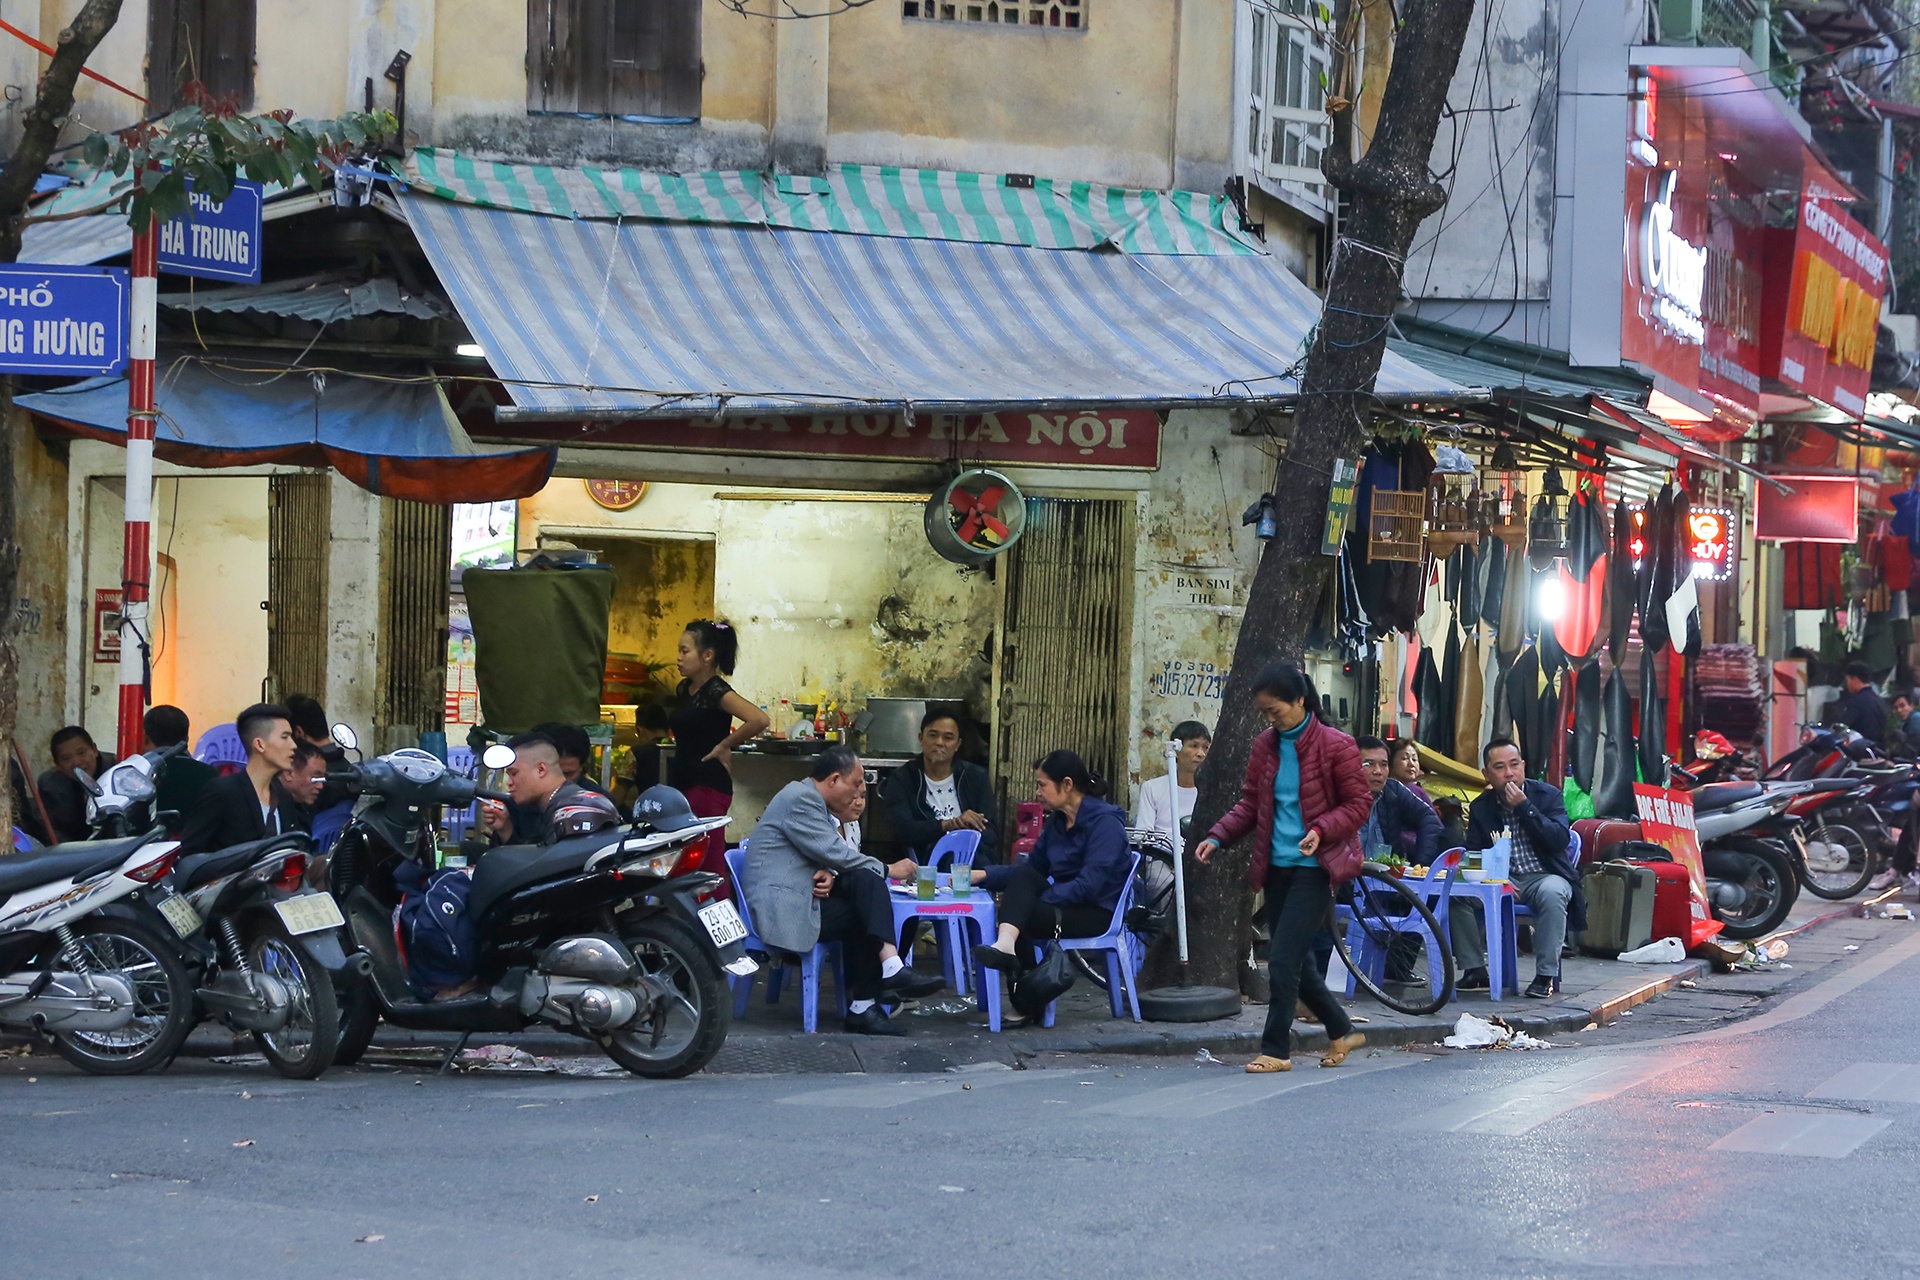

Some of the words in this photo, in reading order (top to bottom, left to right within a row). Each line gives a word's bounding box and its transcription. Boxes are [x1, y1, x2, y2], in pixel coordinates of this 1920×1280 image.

[190, 223, 249, 265] TRUNG
[0, 280, 53, 308] PHỐ
[33, 317, 105, 357] HƯNG
[1026, 410, 1129, 454] NỘI
[1206, 579, 1230, 590] SIM
[704, 904, 734, 926] 29-C1
[711, 919, 745, 943] 600.78
